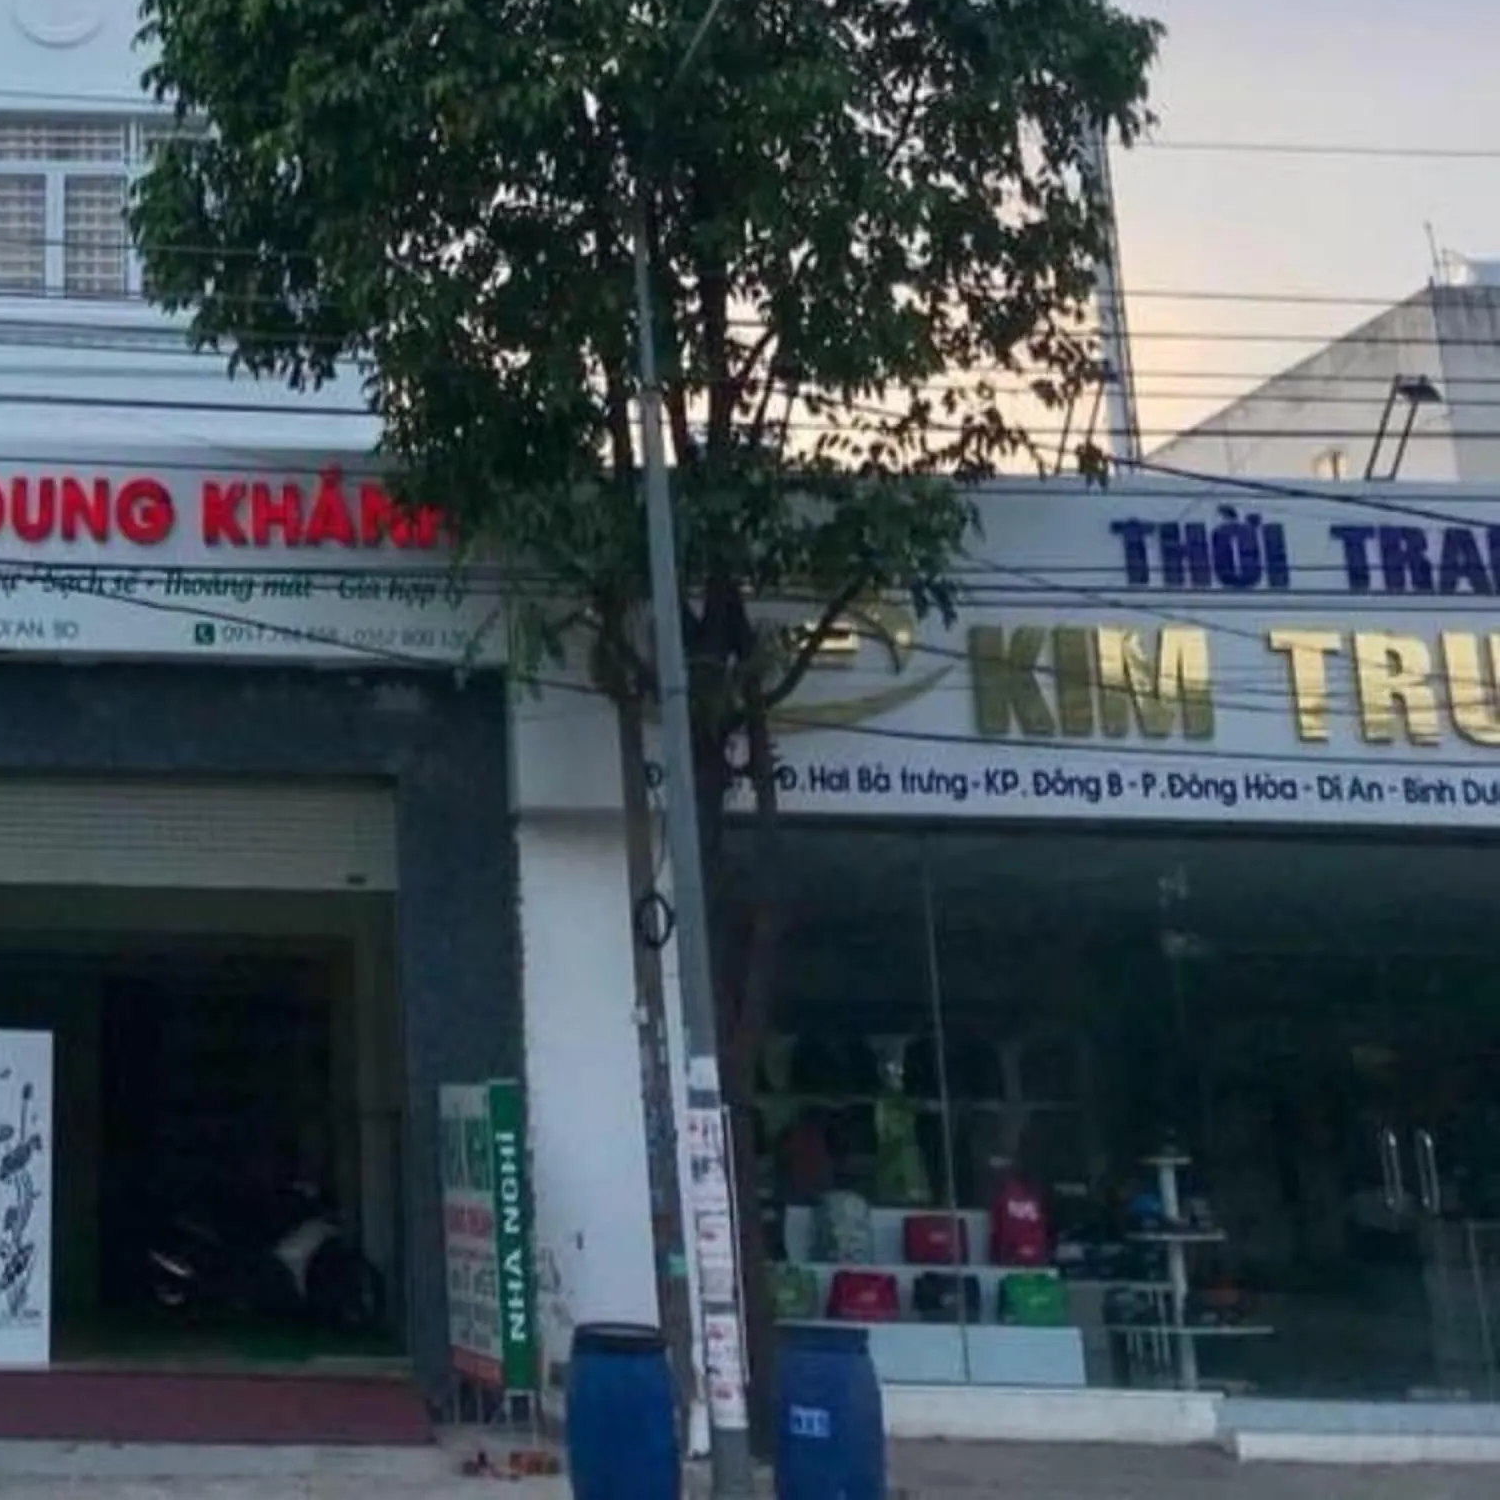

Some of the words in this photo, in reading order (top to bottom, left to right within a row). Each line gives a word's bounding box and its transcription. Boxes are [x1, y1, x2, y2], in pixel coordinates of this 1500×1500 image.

[1109, 502, 1291, 589] THỜI
[1329, 523, 1500, 596] TRA
[967, 624, 1215, 741] KIM
[809, 764, 850, 792] Hai
[1350, 776, 1384, 802] An
